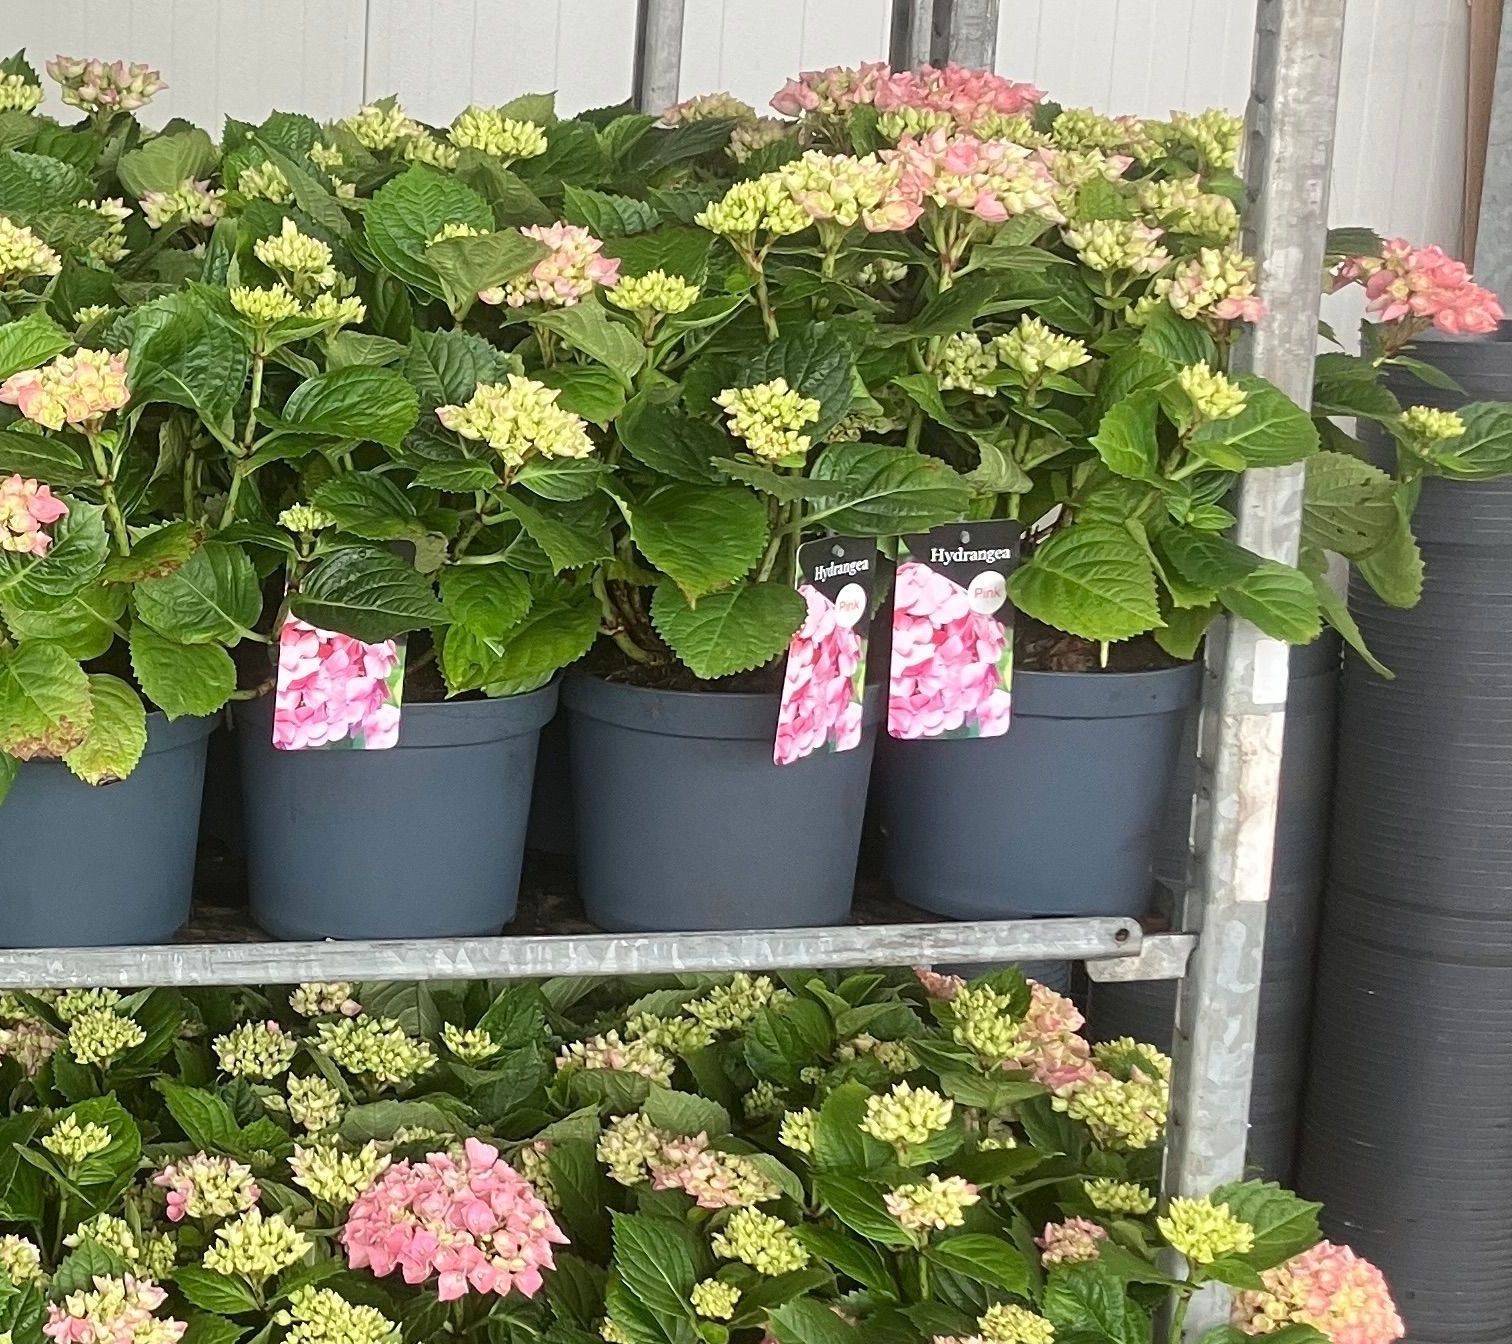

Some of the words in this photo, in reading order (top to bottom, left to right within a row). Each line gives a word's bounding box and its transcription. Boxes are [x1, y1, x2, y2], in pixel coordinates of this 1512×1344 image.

[930, 546, 1011, 566] Hydrangea
[814, 558, 870, 582] Hydrangea
[975, 587, 1001, 599] Pink
[839, 599, 861, 612] Pink
